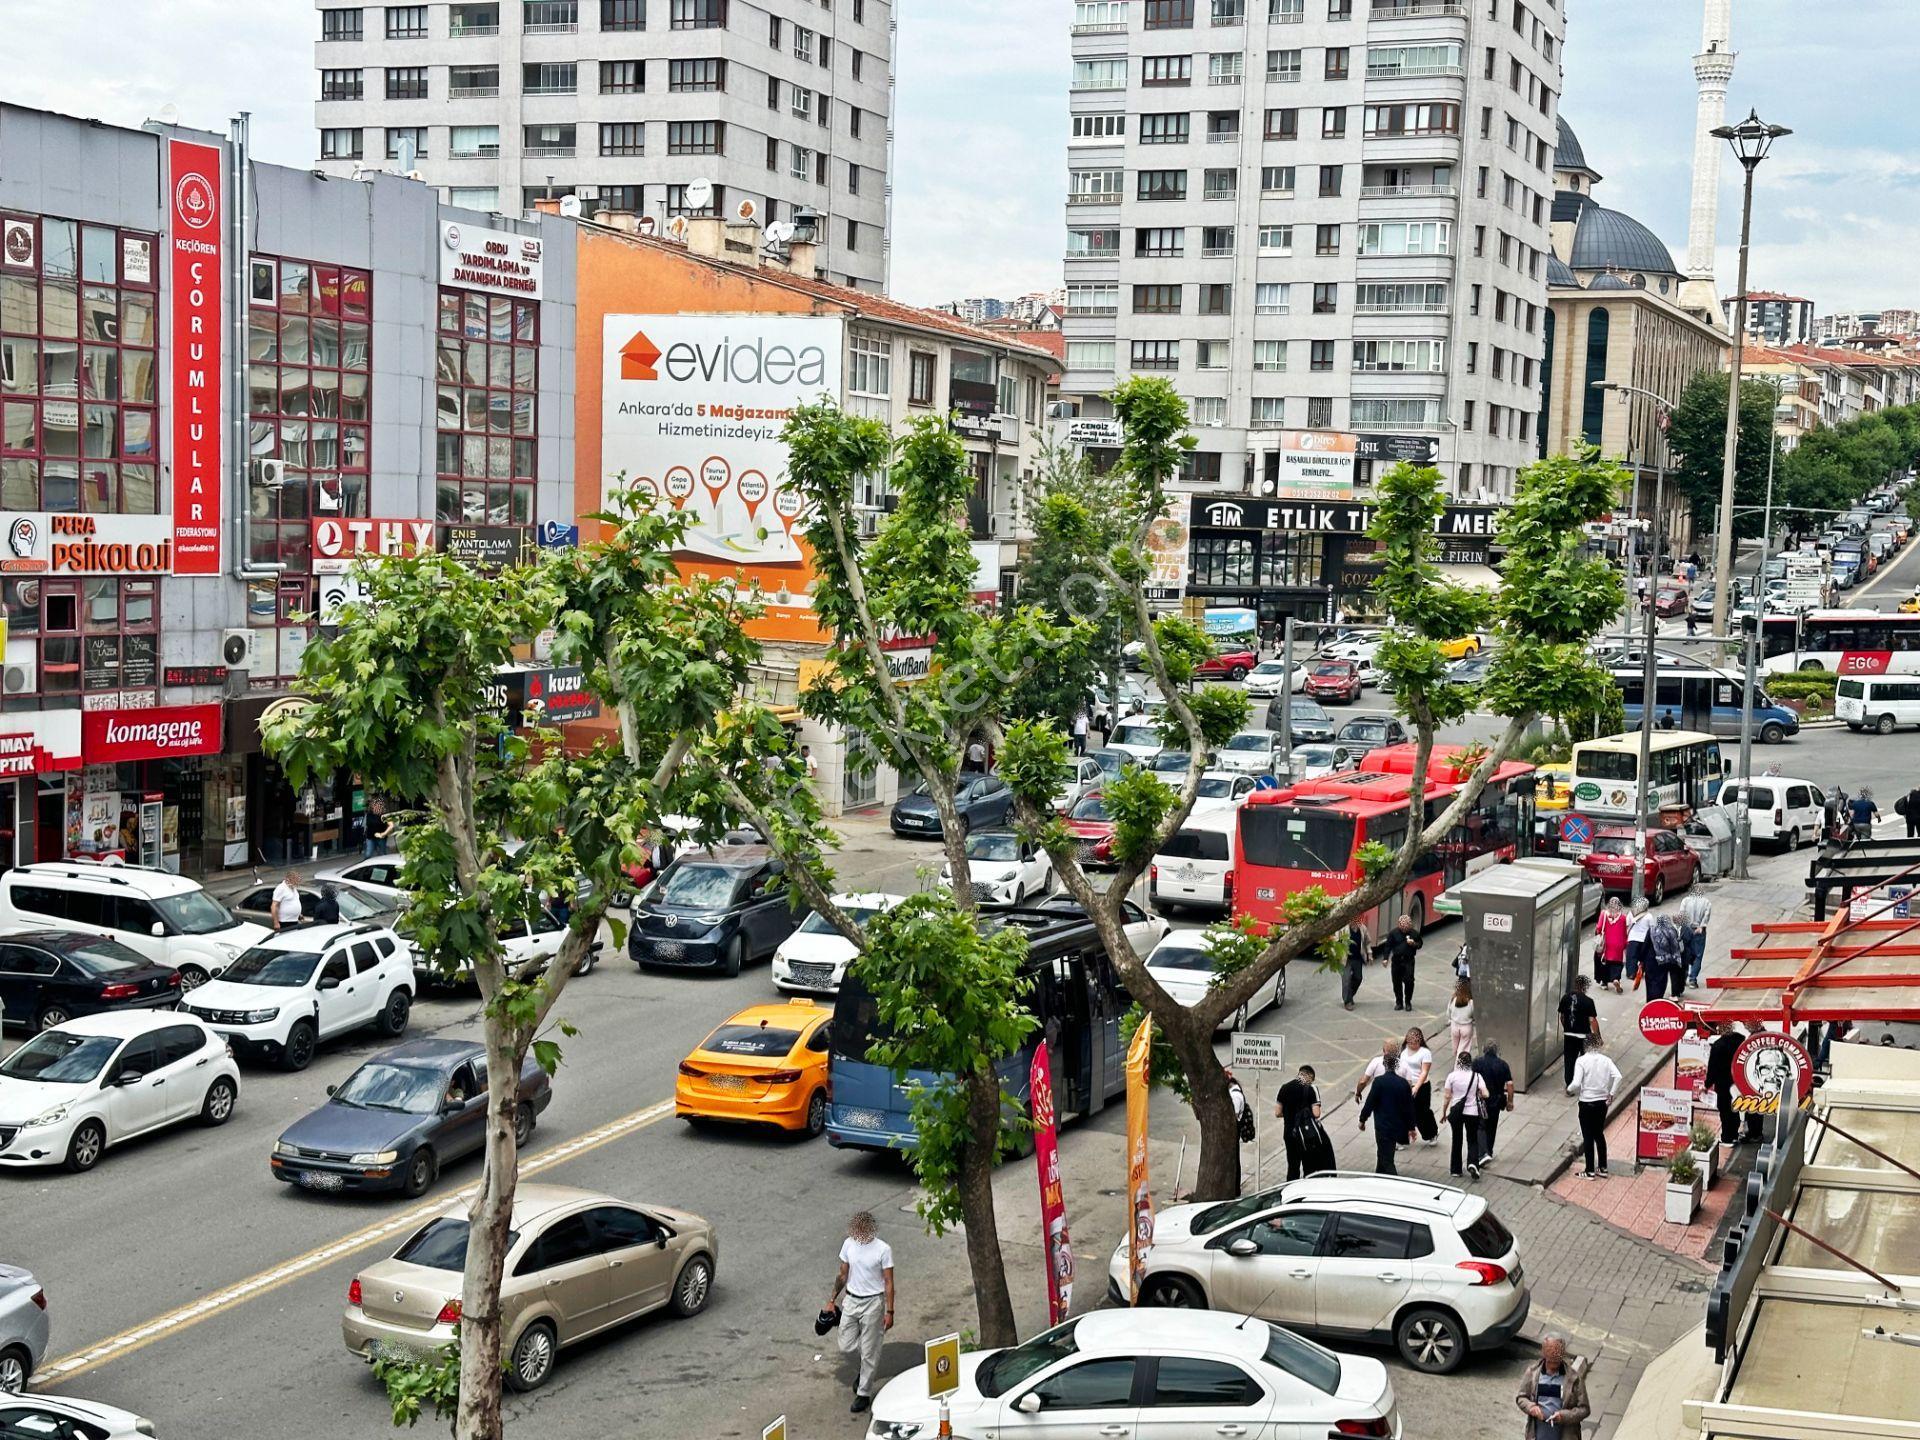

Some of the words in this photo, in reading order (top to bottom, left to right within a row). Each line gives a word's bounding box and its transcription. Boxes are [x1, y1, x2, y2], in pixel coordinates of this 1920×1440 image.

[176, 238, 216, 255] KEÇİÖREN
[485, 240, 509, 255] ORDU
[461, 252, 520, 274] YARDIMLAŞMA
[521, 265, 530, 275] ve
[453, 267, 502, 288] DAYANIŞMA
[503, 276, 537, 292] DERNEĞİ
[665, 336, 826, 386] evidea
[189, 262, 205, 521] ÇORUMLULAR
[618, 401, 693, 417] Ankara'da
[696, 403, 706, 417] 5
[658, 422, 777, 442] Hizmetinizdeyiz.
[1080, 422, 1109, 430] CENGİZ
[1360, 441, 1379, 454] IŞIL
[1286, 455, 1311, 465] BAŞARILI
[1339, 456, 1351, 467] İÇİN
[705, 467, 726, 476] Taurus
[745, 489, 760, 497] AVM
[1267, 503, 1335, 531] ETLİK
[52, 515, 96, 535] PERA
[176, 527, 217, 538] FEDERASYONU
[348, 521, 433, 556] THY
[451, 529, 477, 539] ENIS
[52, 538, 172, 572] PSİKOLOJİ
[1448, 551, 1483, 563] FIRIN
[1148, 589, 1166, 598] LOFT
[1848, 656, 1880, 669] EGO
[106, 719, 201, 748] komagene
[0, 755, 34, 773] PTİK
[1487, 917, 1509, 927] EGO
[1243, 1039, 1272, 1047] OTOPARK
[1236, 1046, 1258, 1055] BİNAYA
[1259, 1048, 1279, 1057] AİTTİR
[1736, 1050, 1749, 1065] THE
[1746, 1037, 1776, 1051] COFFEE
[1778, 1038, 1809, 1070] COMPANY
[1251, 1058, 1280, 1066] YASAKTIR
